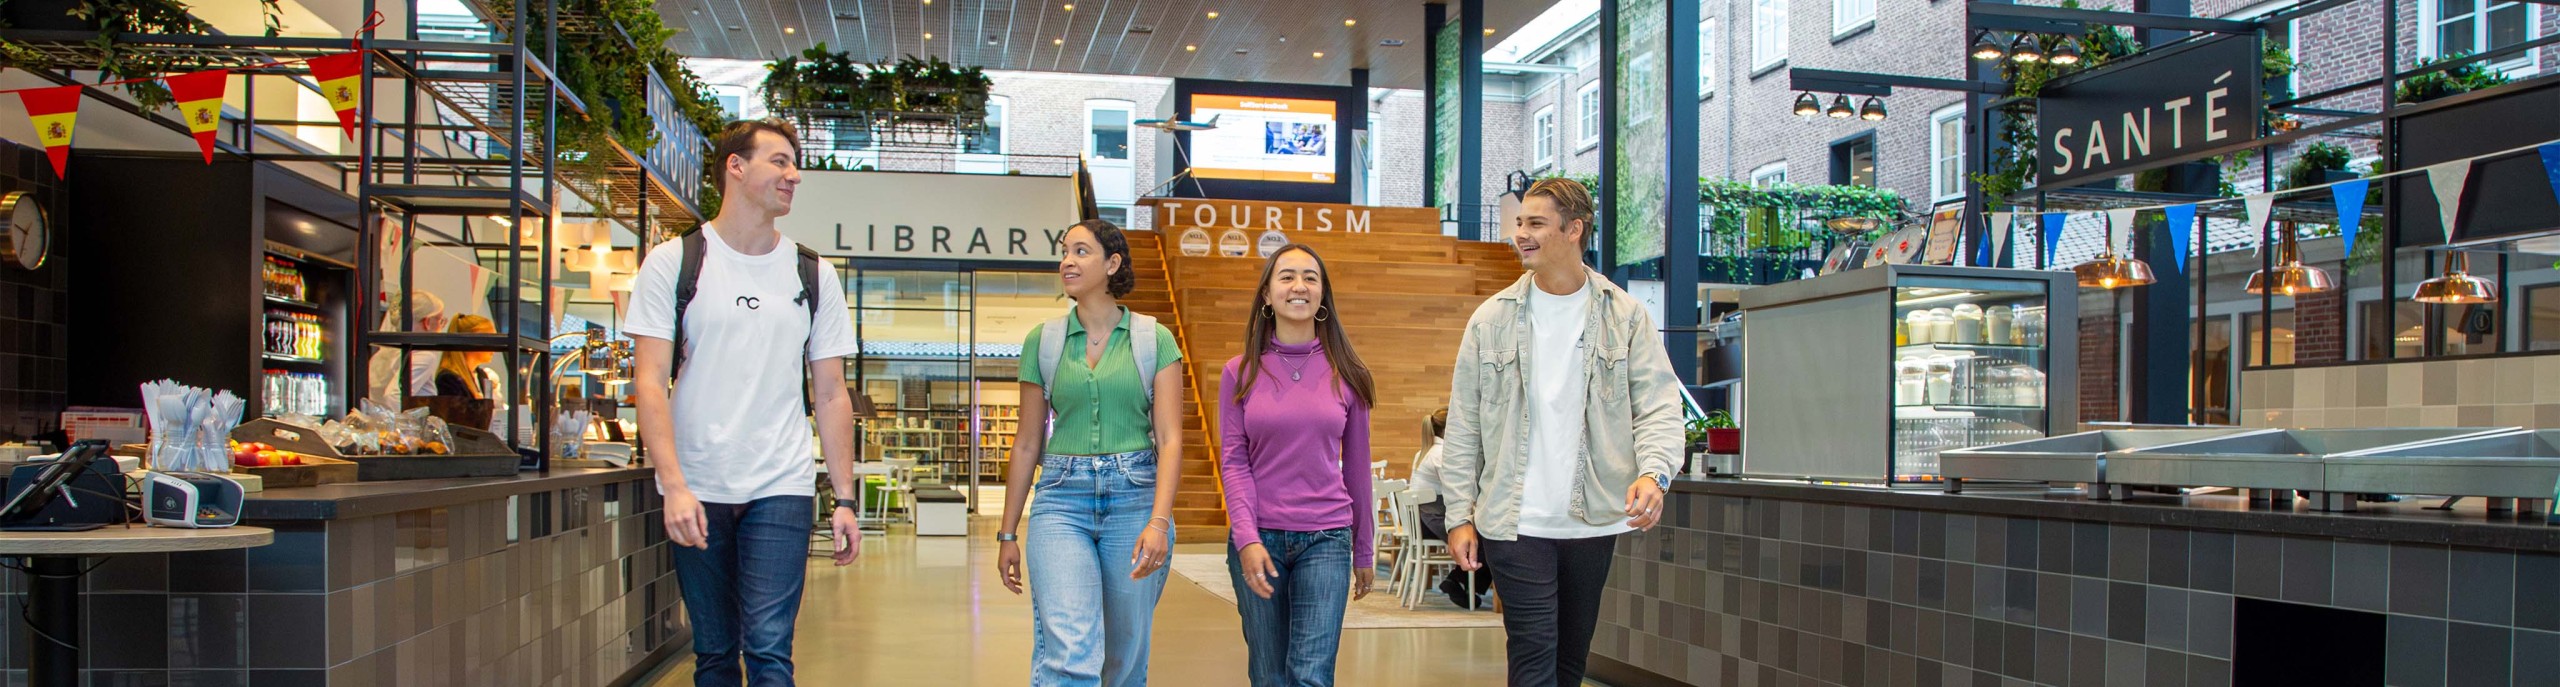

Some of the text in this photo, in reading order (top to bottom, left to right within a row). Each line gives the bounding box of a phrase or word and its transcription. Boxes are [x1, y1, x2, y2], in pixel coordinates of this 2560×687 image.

[652, 84, 701, 162] MONSIEUR
[2053, 69, 2233, 176] SANTÉ
[652, 121, 700, 206] CROQUE
[835, 223, 1064, 255] LIBRARY
[1163, 202, 1371, 233] TOURISM
